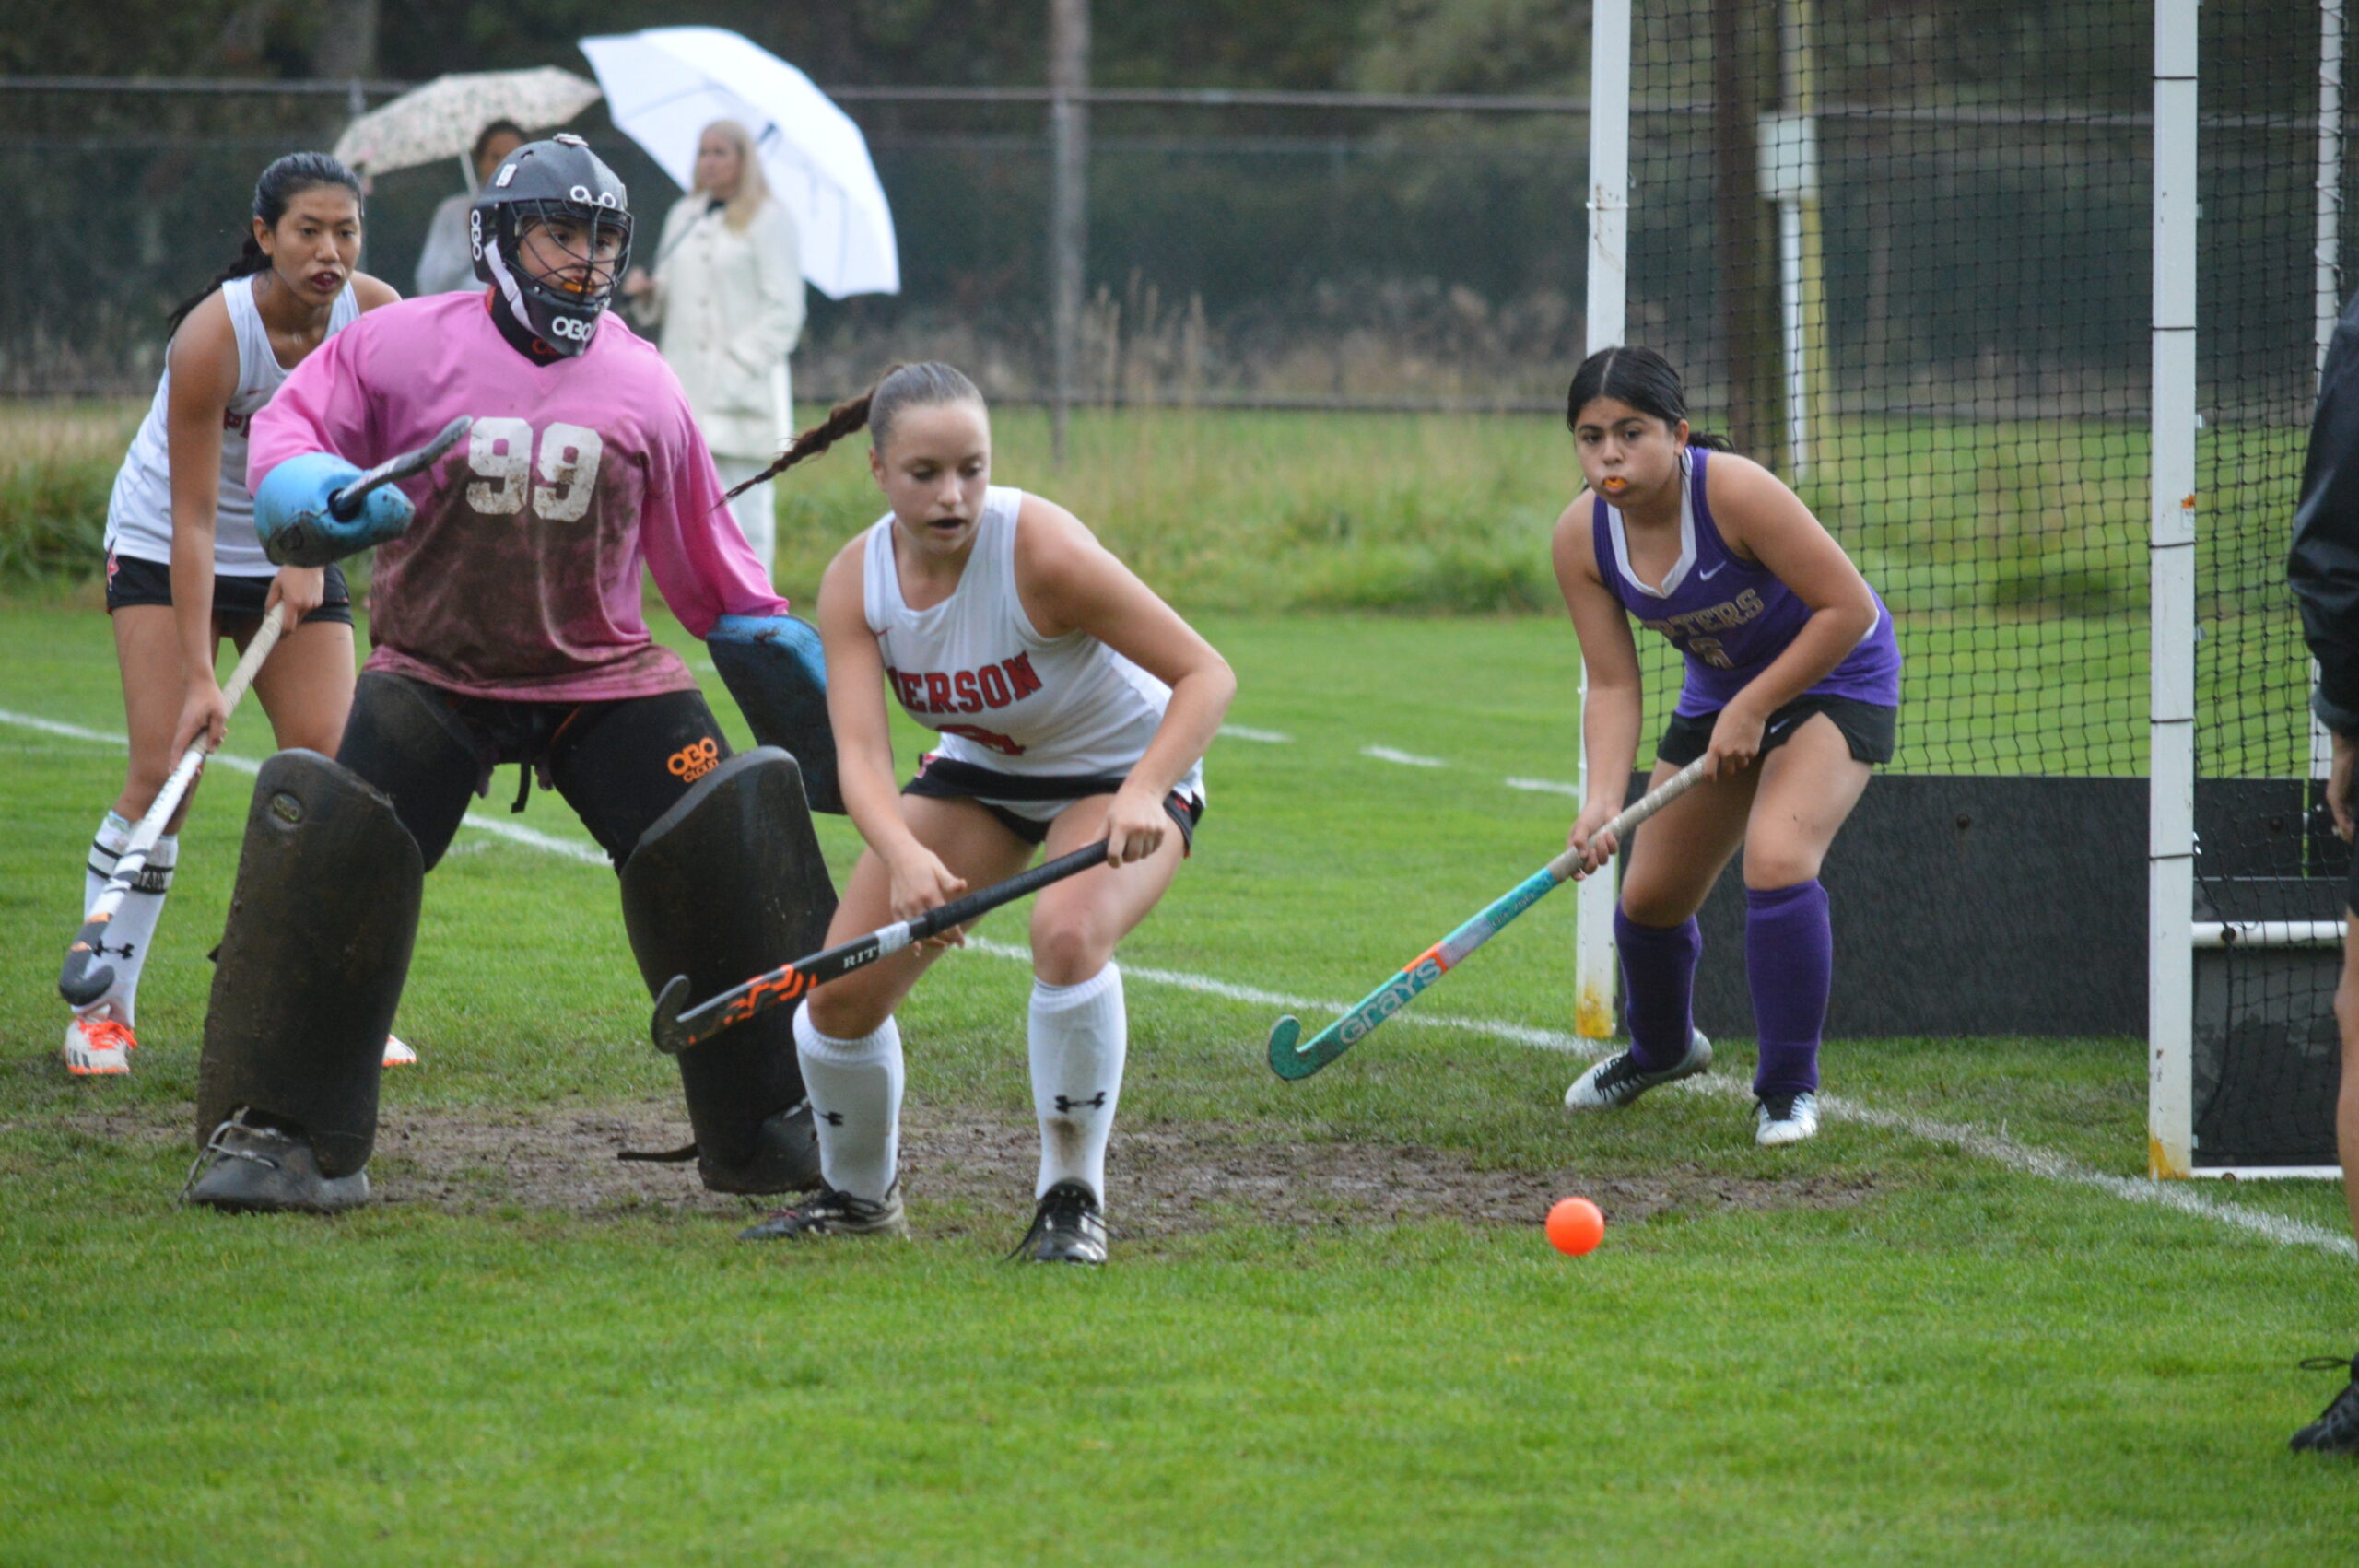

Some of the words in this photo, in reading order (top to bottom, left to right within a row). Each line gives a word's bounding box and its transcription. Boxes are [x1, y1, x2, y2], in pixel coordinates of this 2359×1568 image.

[471, 209, 483, 261] OBO
[552, 316, 593, 341] OBO
[466, 416, 604, 523] 99
[667, 737, 718, 776] OBO
